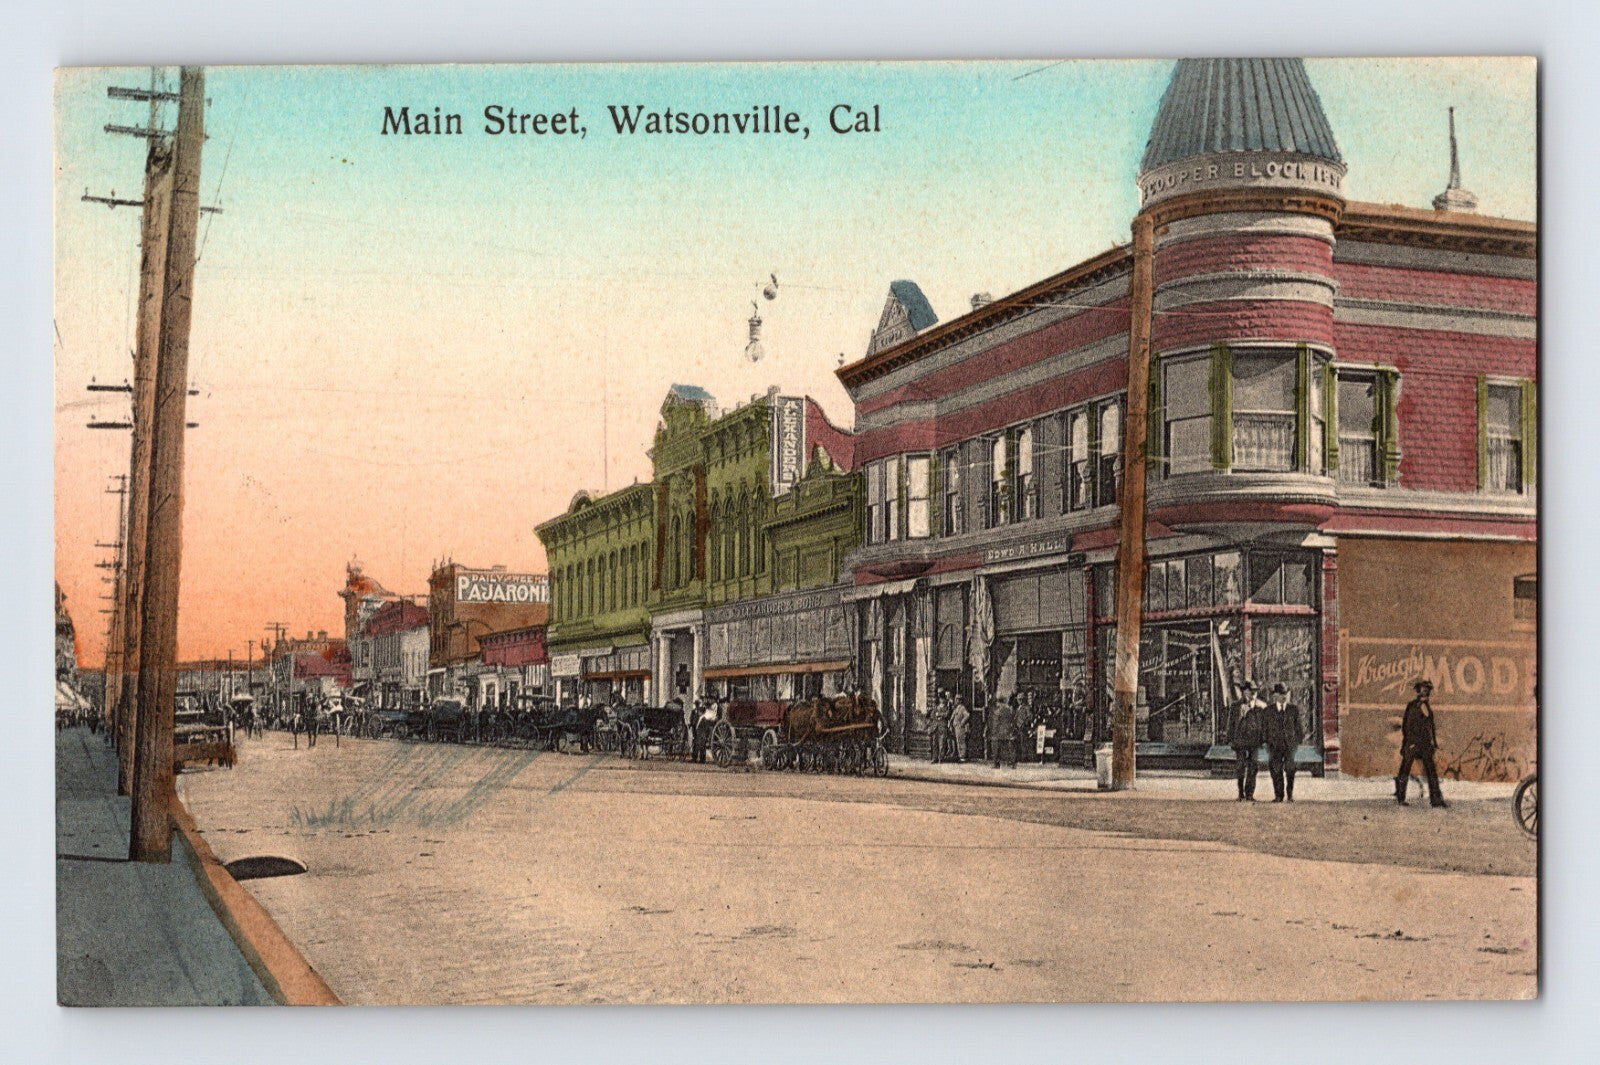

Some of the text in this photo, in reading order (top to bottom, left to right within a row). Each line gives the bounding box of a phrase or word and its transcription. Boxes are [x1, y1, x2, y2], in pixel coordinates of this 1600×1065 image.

[1233, 161, 1306, 179] BLOCK
[471, 574, 504, 583] DAILY
[512, 576, 549, 584] WEEKL
